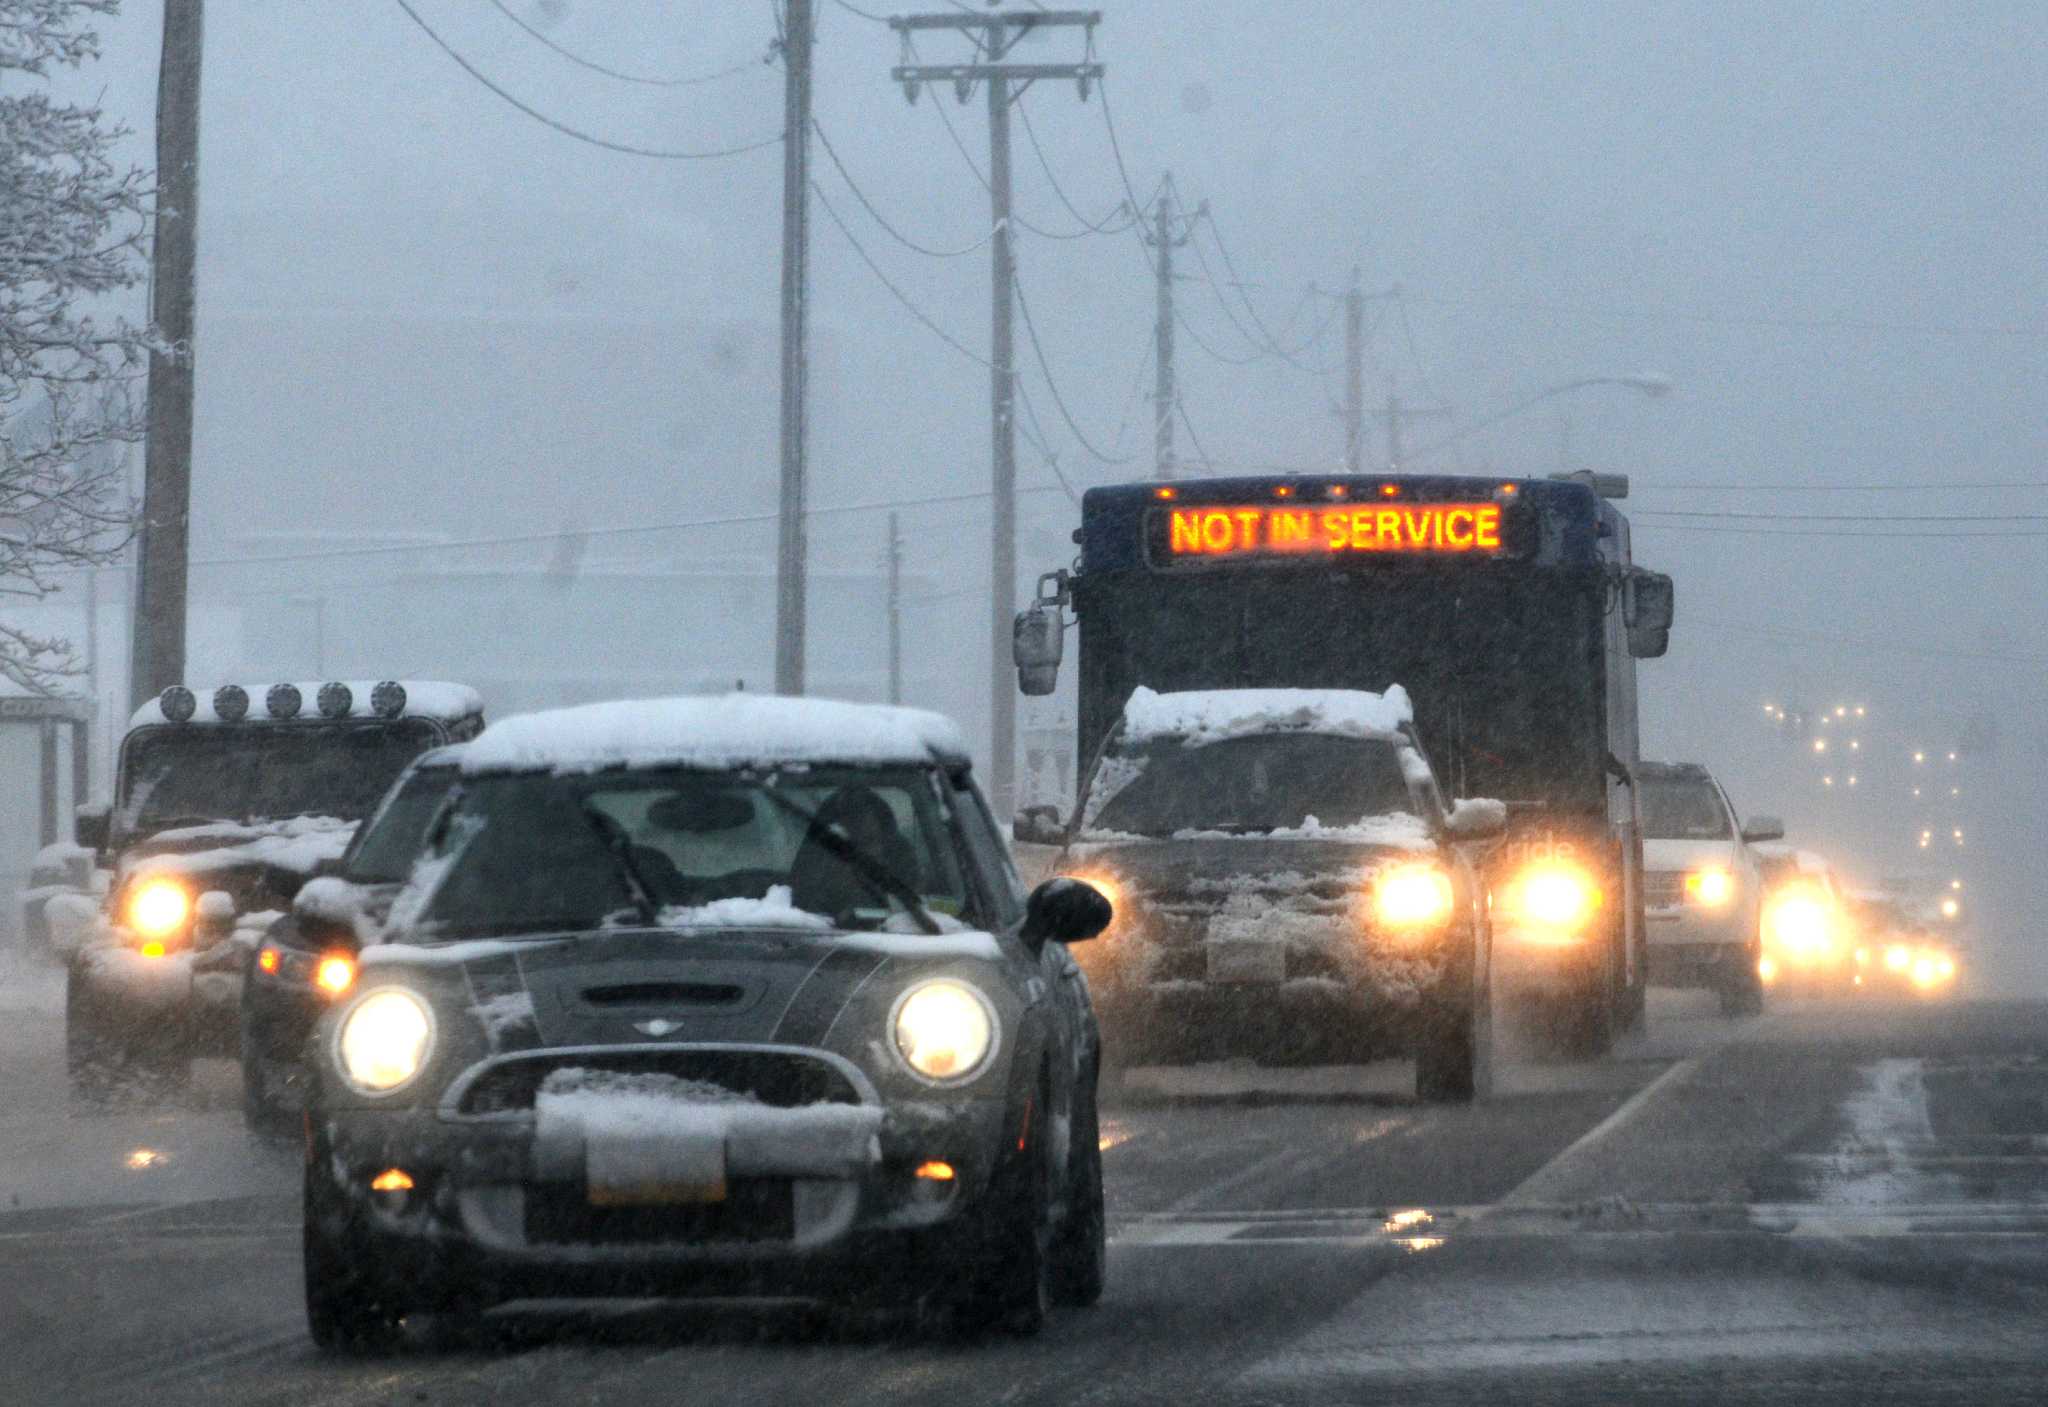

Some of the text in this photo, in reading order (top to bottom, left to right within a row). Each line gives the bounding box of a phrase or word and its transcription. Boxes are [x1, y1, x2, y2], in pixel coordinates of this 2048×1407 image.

[1172, 506, 1499, 549] NOT IN SERVICE
